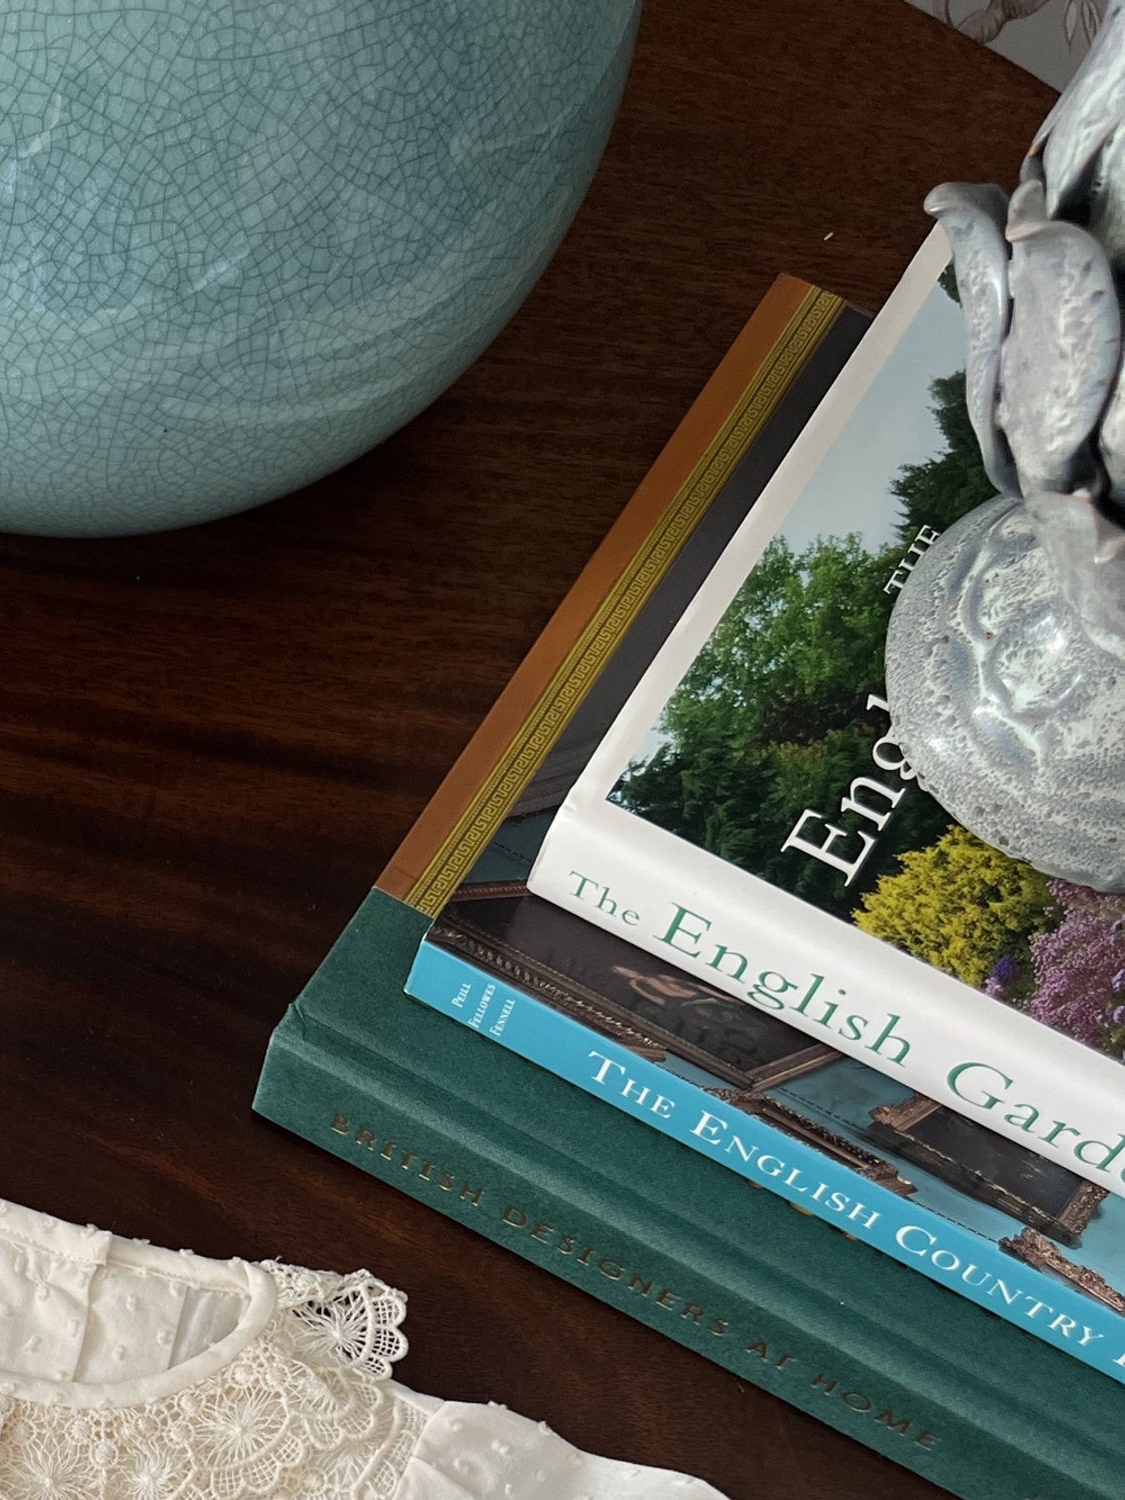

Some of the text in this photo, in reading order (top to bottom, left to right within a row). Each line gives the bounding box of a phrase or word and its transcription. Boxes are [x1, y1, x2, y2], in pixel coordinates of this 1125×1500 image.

[780, 693, 919, 888] Eng
[569, 870, 1125, 1186] The English Gard
[330, 1112, 485, 1207] BRITISH
[502, 1205, 729, 1337] DESIGNERS
[746, 1340, 796, 1370] AT
[811, 1373, 943, 1451] HOME
[588, 1050, 675, 1119] THE
[690, 1110, 882, 1230] ENGLISH
[895, 1225, 1105, 1347] COUNTRY
